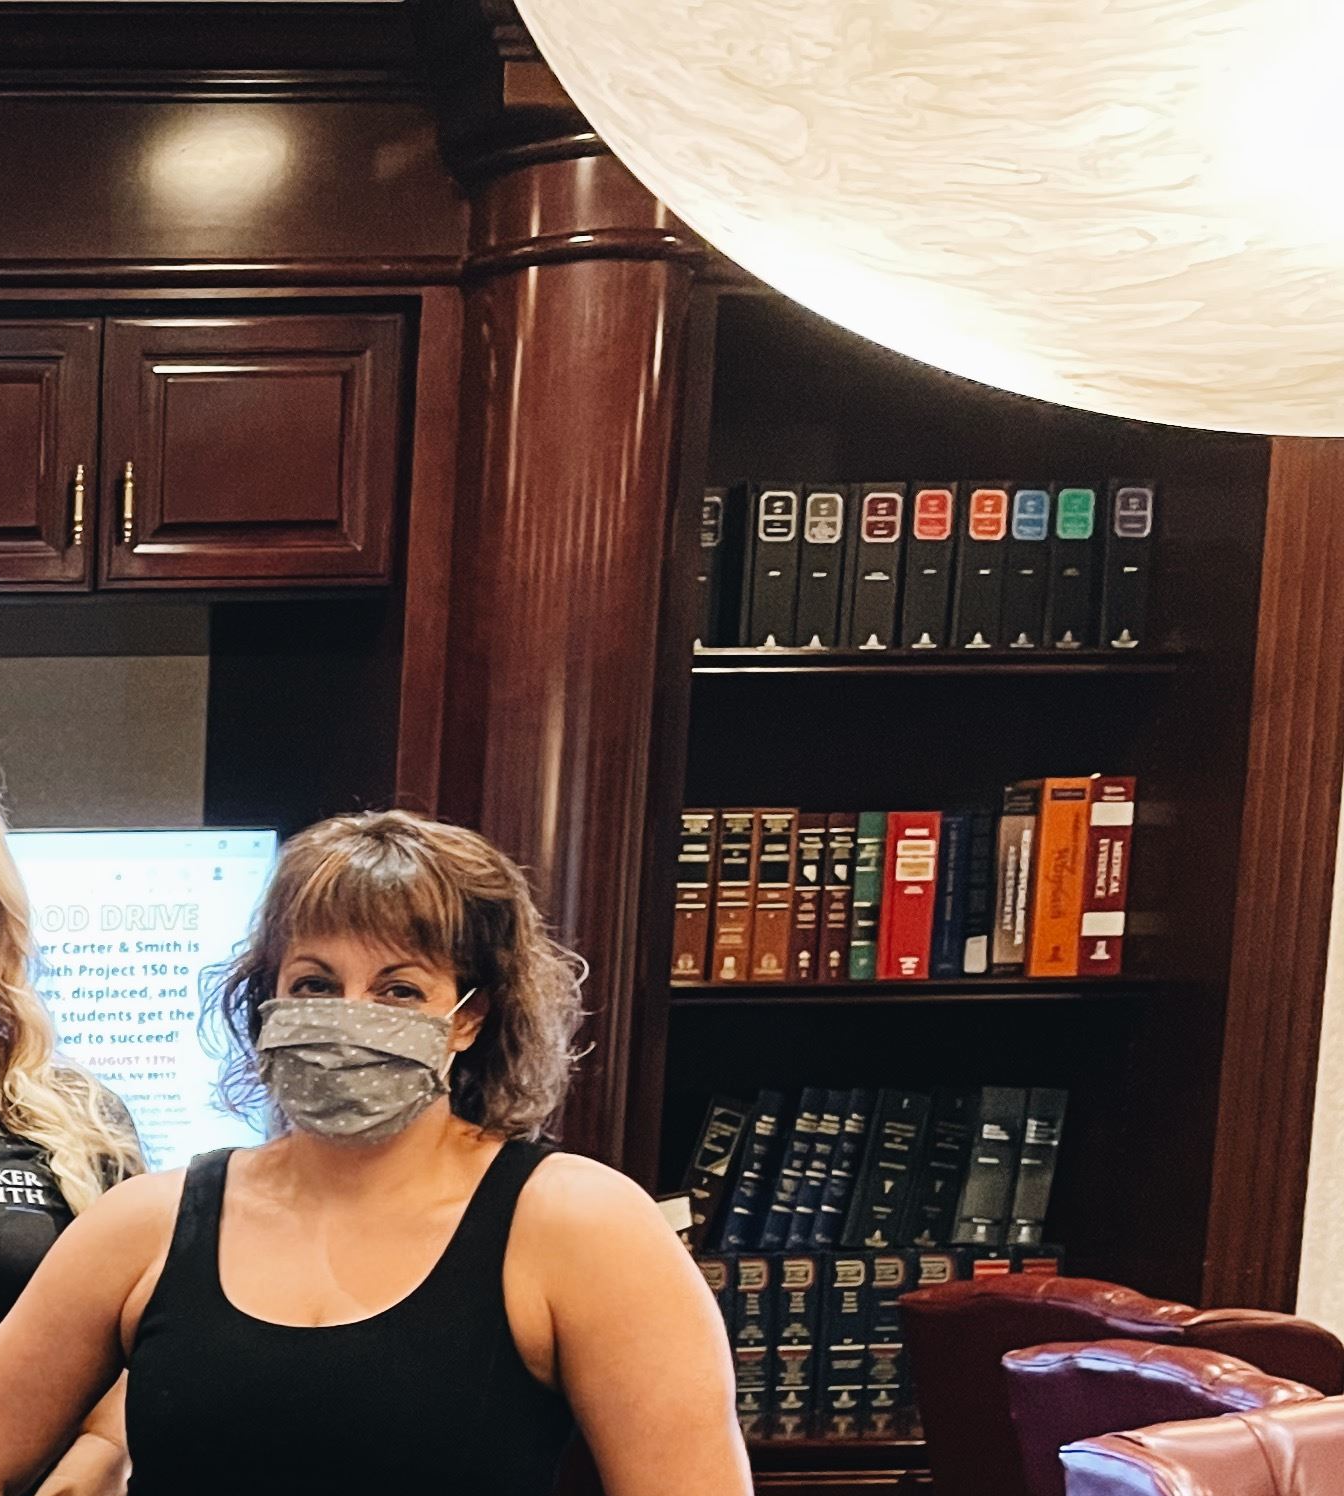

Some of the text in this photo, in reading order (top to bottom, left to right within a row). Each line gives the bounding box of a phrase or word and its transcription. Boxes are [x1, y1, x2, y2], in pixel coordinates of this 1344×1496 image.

[100, 903, 200, 932] DRIVE
[62, 940, 200, 955] Carter & Smith is
[79, 964, 189, 980] Project 150 to
[71, 985, 188, 1003] displaced, and
[62, 1009, 195, 1024] students get the
[88, 1031, 179, 1044] to succeed!
